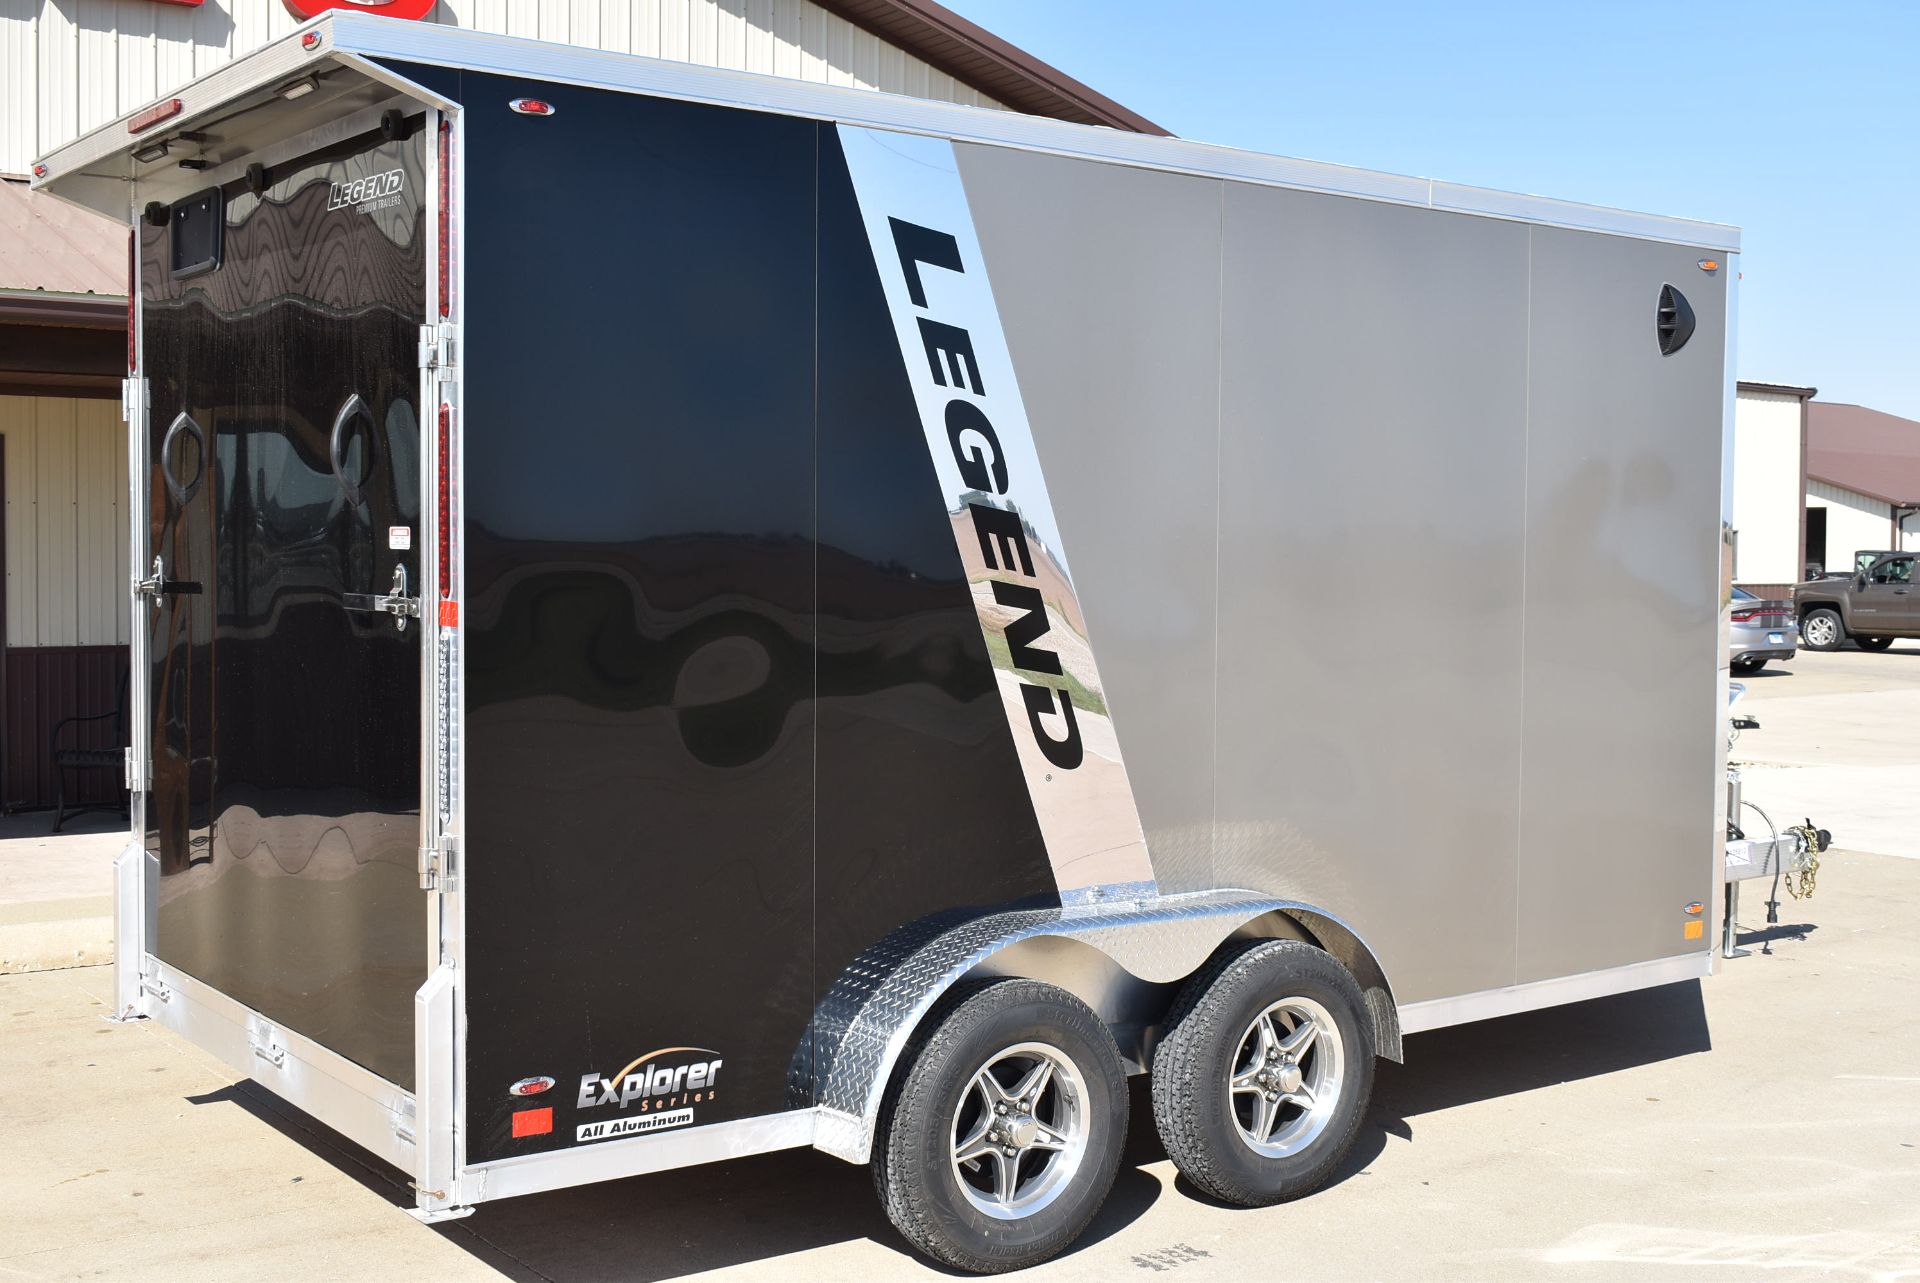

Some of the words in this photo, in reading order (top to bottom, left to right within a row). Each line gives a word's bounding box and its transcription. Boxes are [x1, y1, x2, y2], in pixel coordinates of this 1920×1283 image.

[327, 168, 405, 212] LEGEND
[356, 201, 377, 216] PREMIUM
[378, 194, 401, 210] TRAILERS
[887, 215, 1084, 771] LEGEND
[576, 1059, 723, 1109] Explorer
[640, 1090, 716, 1112] Series
[580, 1124, 605, 1139] All
[609, 1112, 691, 1135] Aluminum
